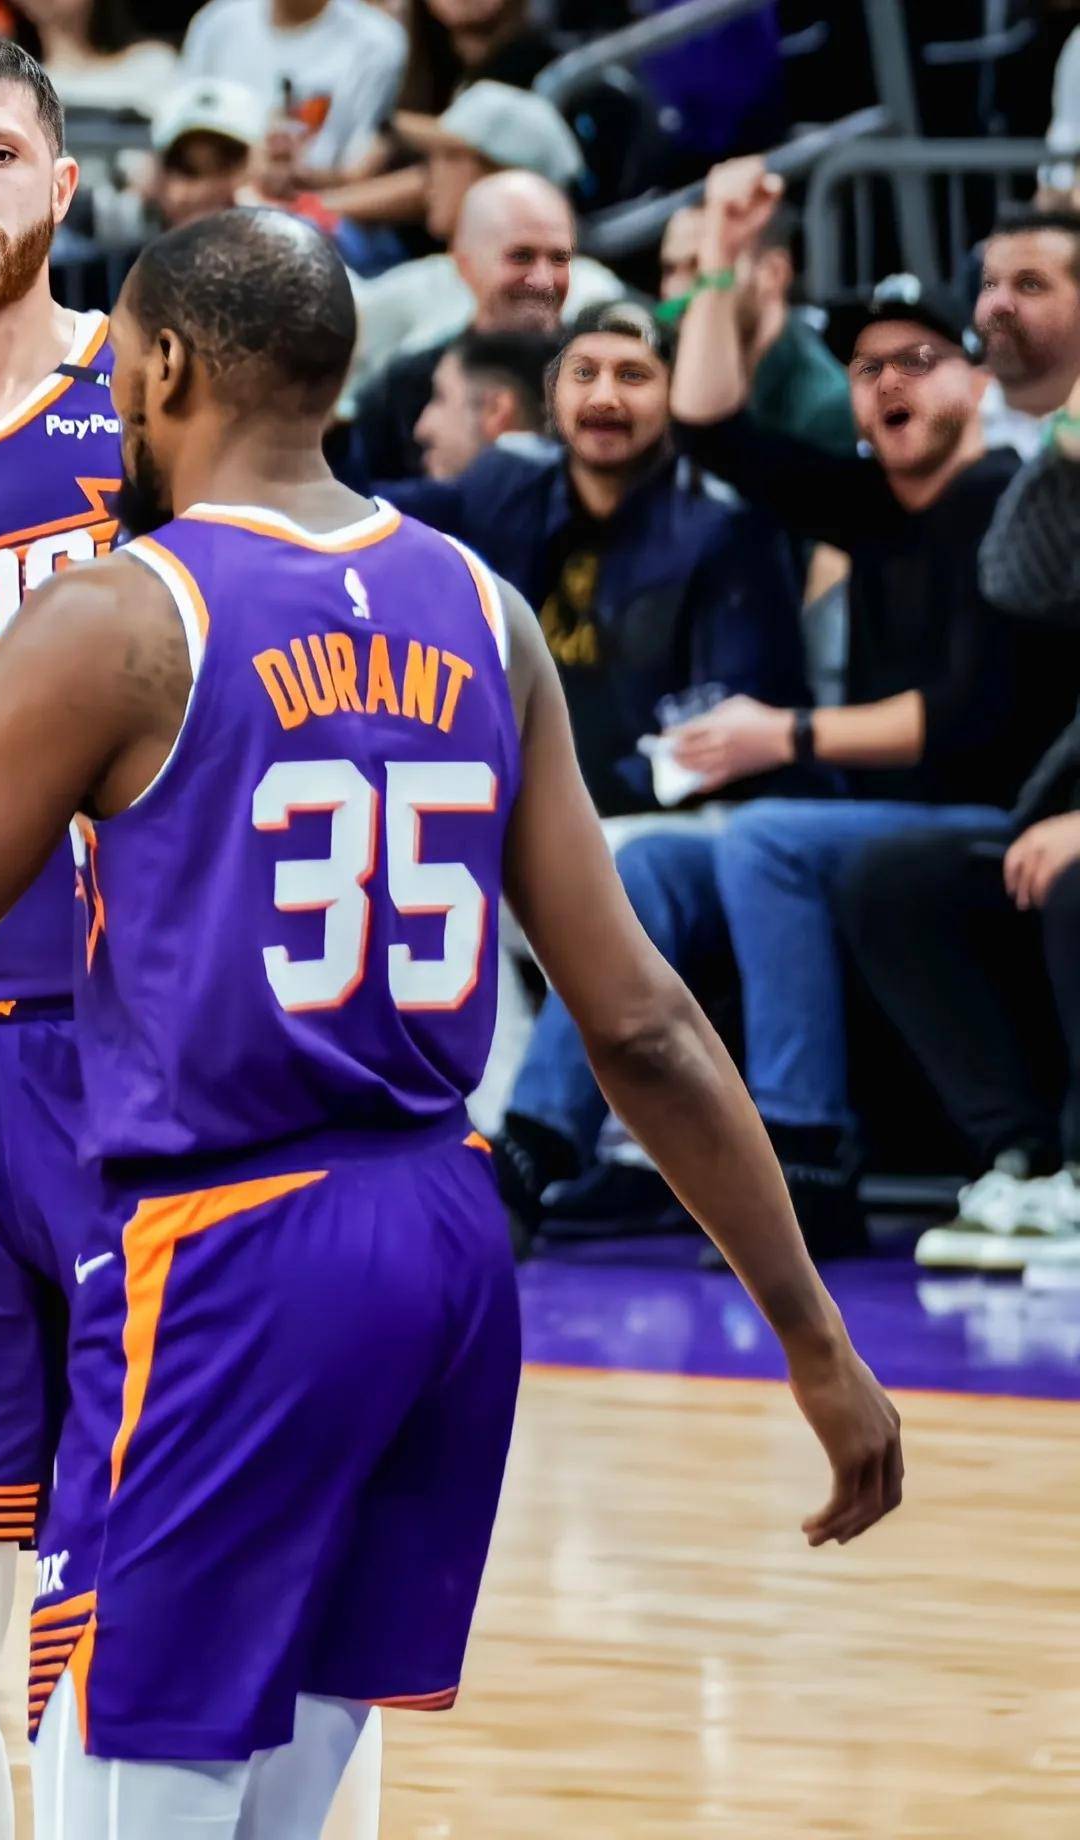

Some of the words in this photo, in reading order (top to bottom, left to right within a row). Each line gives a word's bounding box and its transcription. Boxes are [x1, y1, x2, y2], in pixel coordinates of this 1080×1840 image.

[45, 413, 123, 440] PayPa
[251, 632, 474, 733] DURANT
[252, 758, 497, 1012] 35
